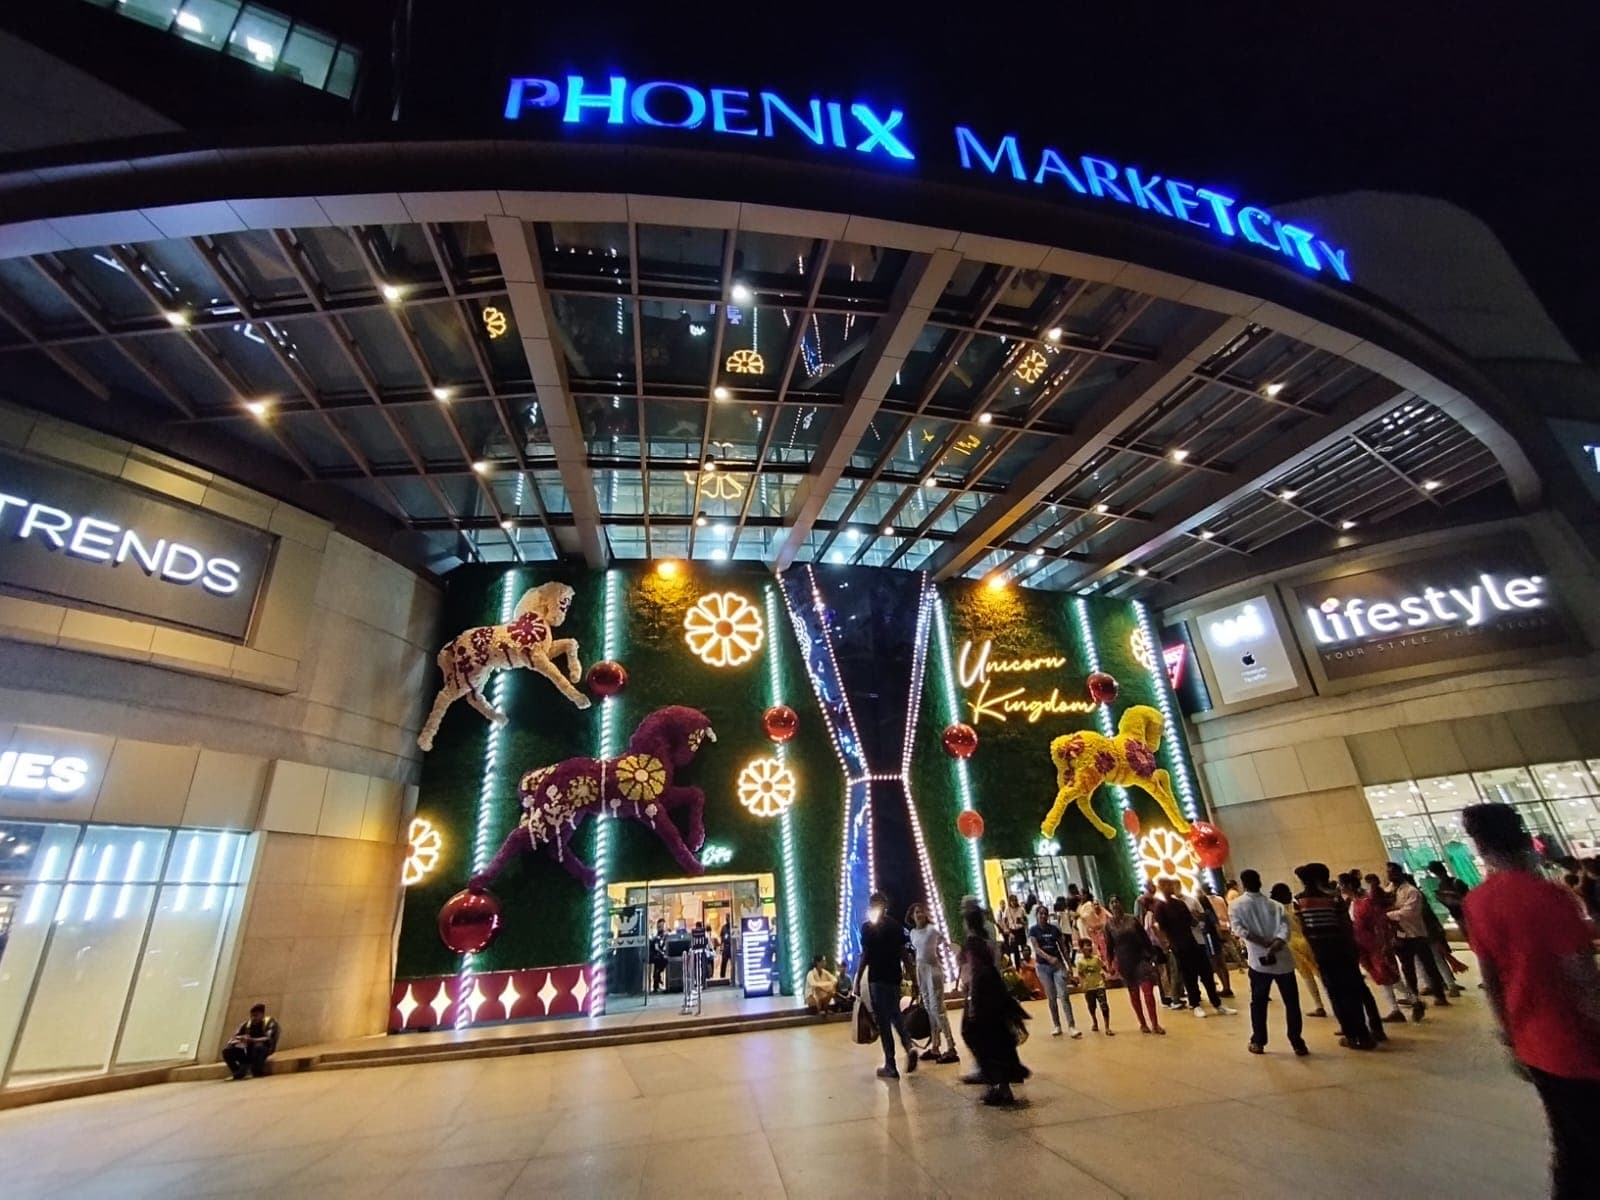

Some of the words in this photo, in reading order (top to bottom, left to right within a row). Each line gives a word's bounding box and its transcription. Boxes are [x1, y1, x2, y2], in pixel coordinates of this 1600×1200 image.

[504, 75, 915, 160] PHOENIX
[954, 126, 1352, 283] MARKETCITY
[1307, 572, 1542, 644] lifestyle
[959, 640, 1066, 688] Unicorn
[1324, 648, 1365, 661] YOUR
[1376, 636, 1430, 652] STYLE
[967, 680, 1096, 724] Kingdom
